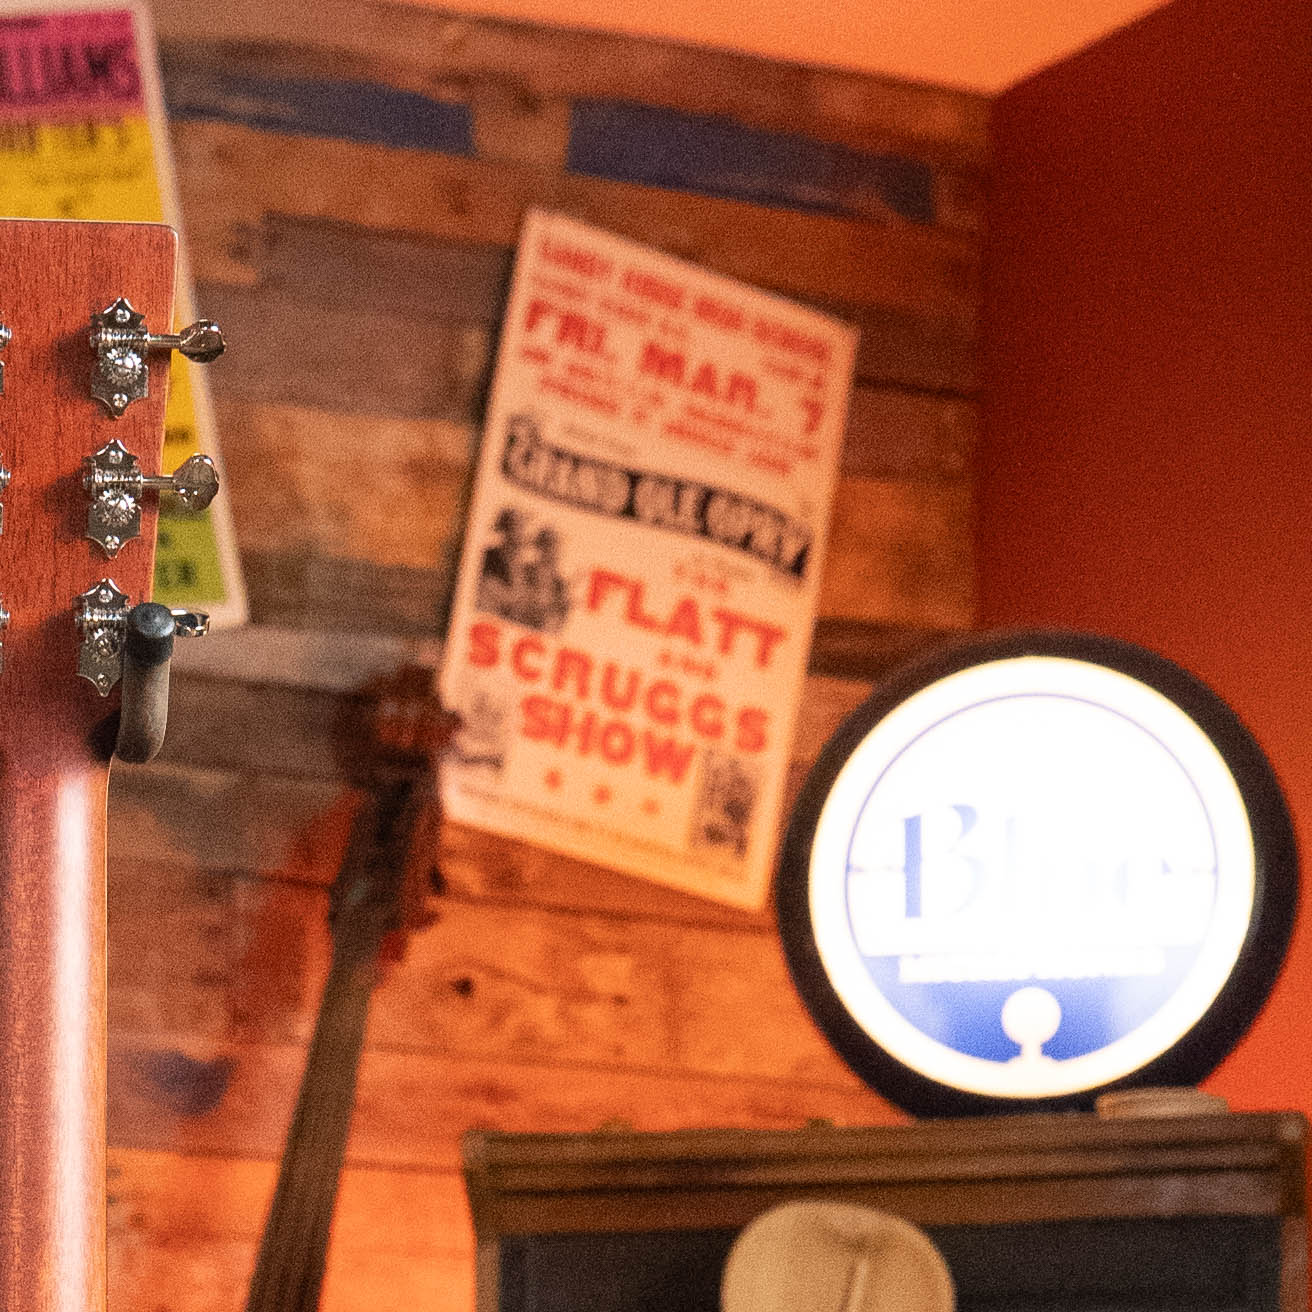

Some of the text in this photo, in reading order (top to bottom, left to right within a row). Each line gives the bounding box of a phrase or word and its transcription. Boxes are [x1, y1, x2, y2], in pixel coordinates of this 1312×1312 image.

[505, 412, 628, 514] GRAND
[704, 490, 812, 576] OPRY
[587, 568, 788, 669] FLATT
[468, 620, 771, 754] SCRUGGS
[519, 693, 697, 787] SHOW
